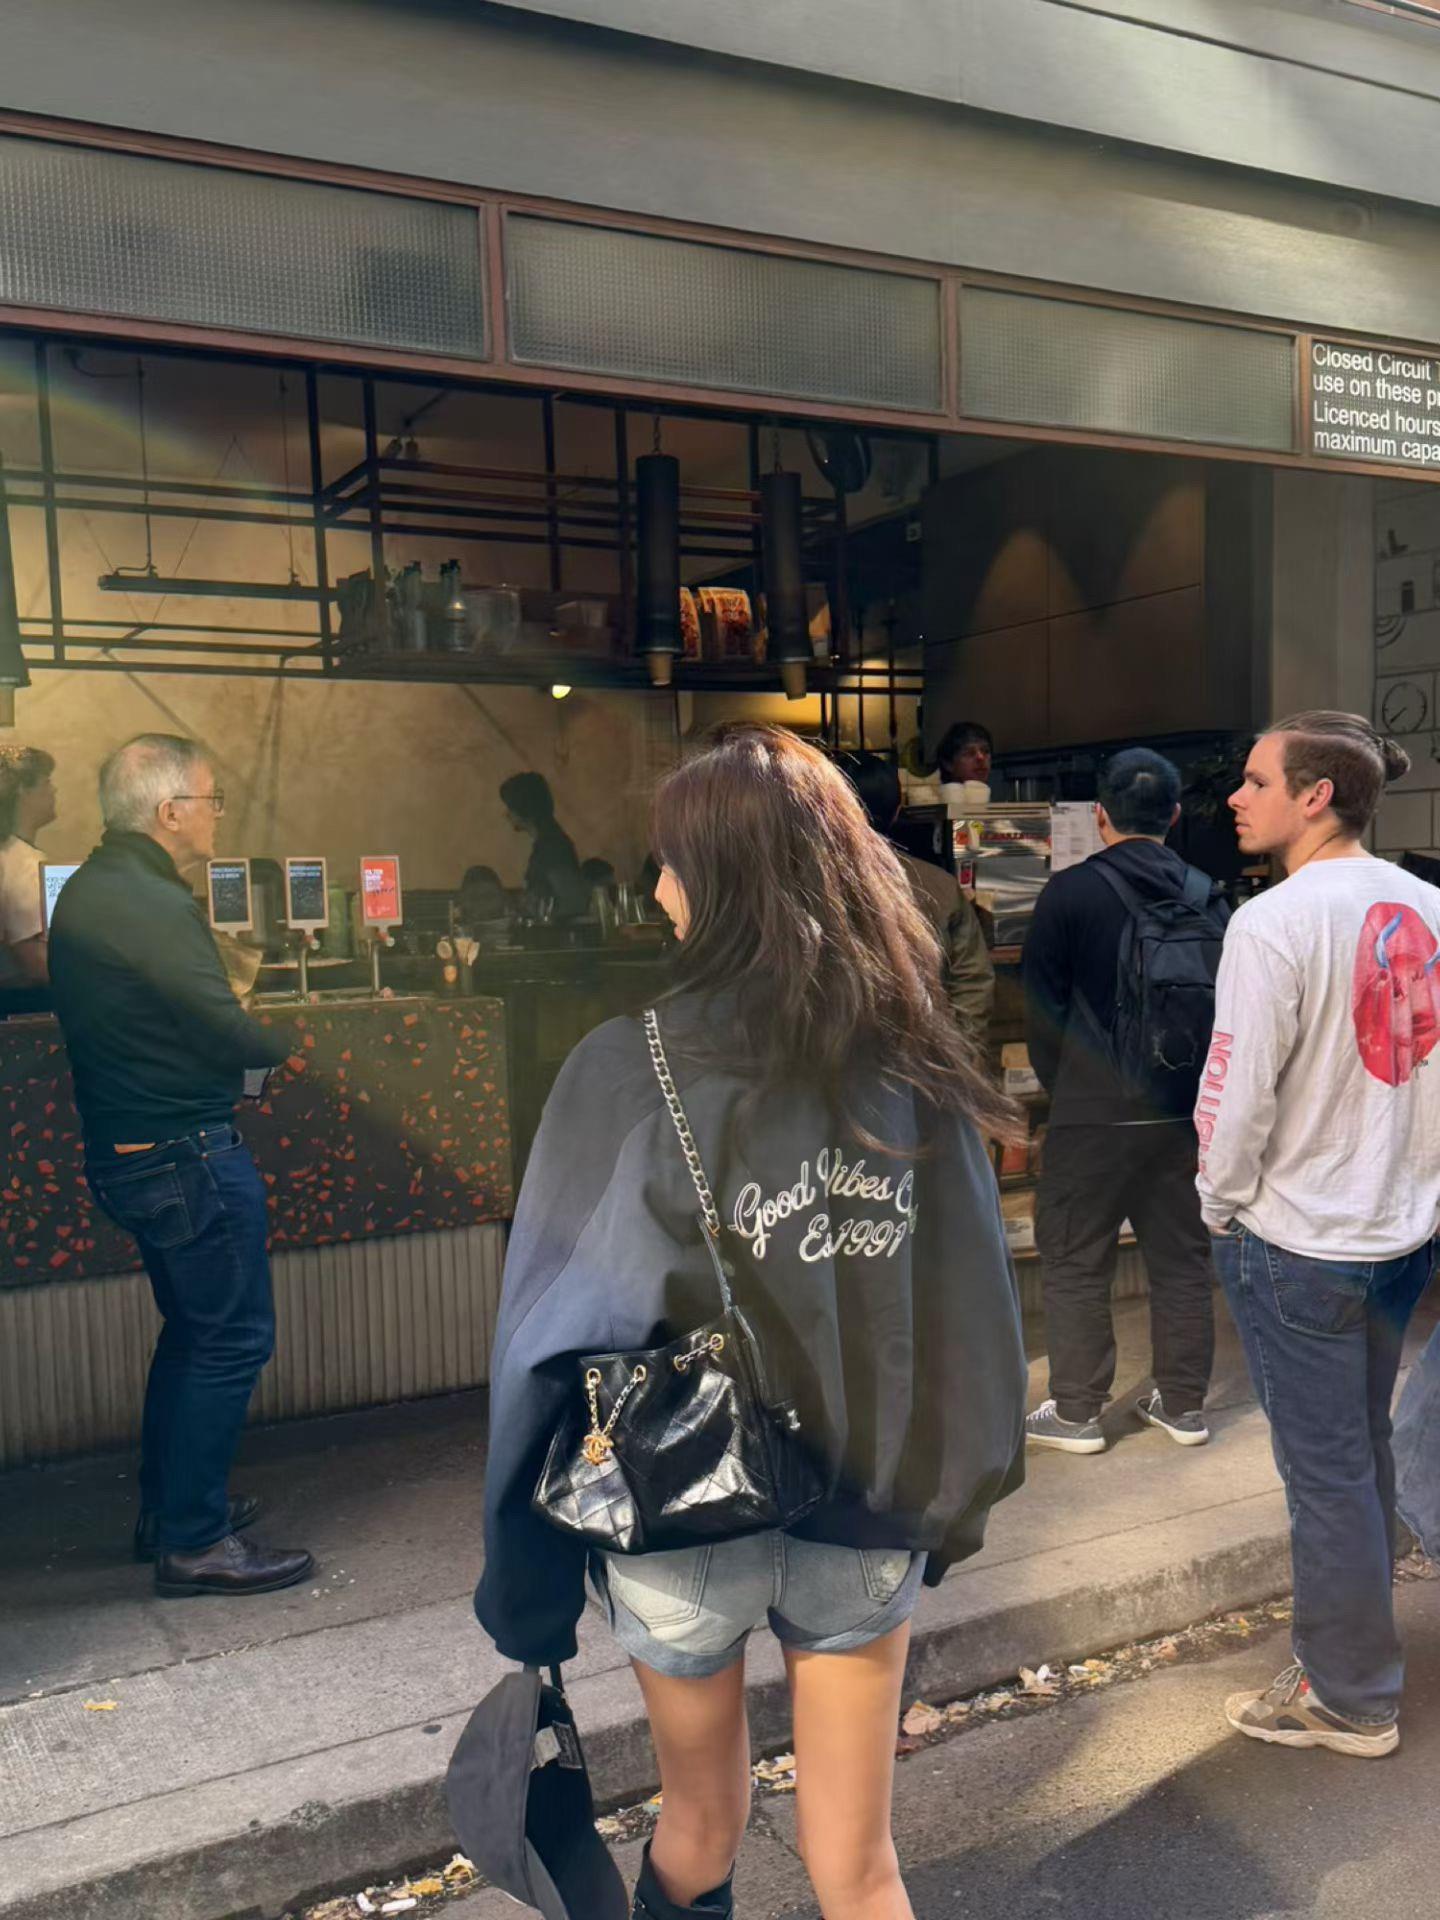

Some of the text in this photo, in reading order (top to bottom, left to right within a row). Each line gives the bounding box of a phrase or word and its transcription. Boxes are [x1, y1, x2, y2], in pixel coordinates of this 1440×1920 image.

[1312, 343, 1373, 372] Closed
[1378, 353, 1431, 381] Circuit
[1313, 374, 1344, 393] use
[1350, 379, 1371, 397] on
[1376, 378, 1421, 404] these
[1313, 400, 1440, 437] Licenced hours
[1314, 430, 1397, 457] maximum
[727, 1161, 816, 1260] Good
[816, 1147, 894, 1201] Vibes
